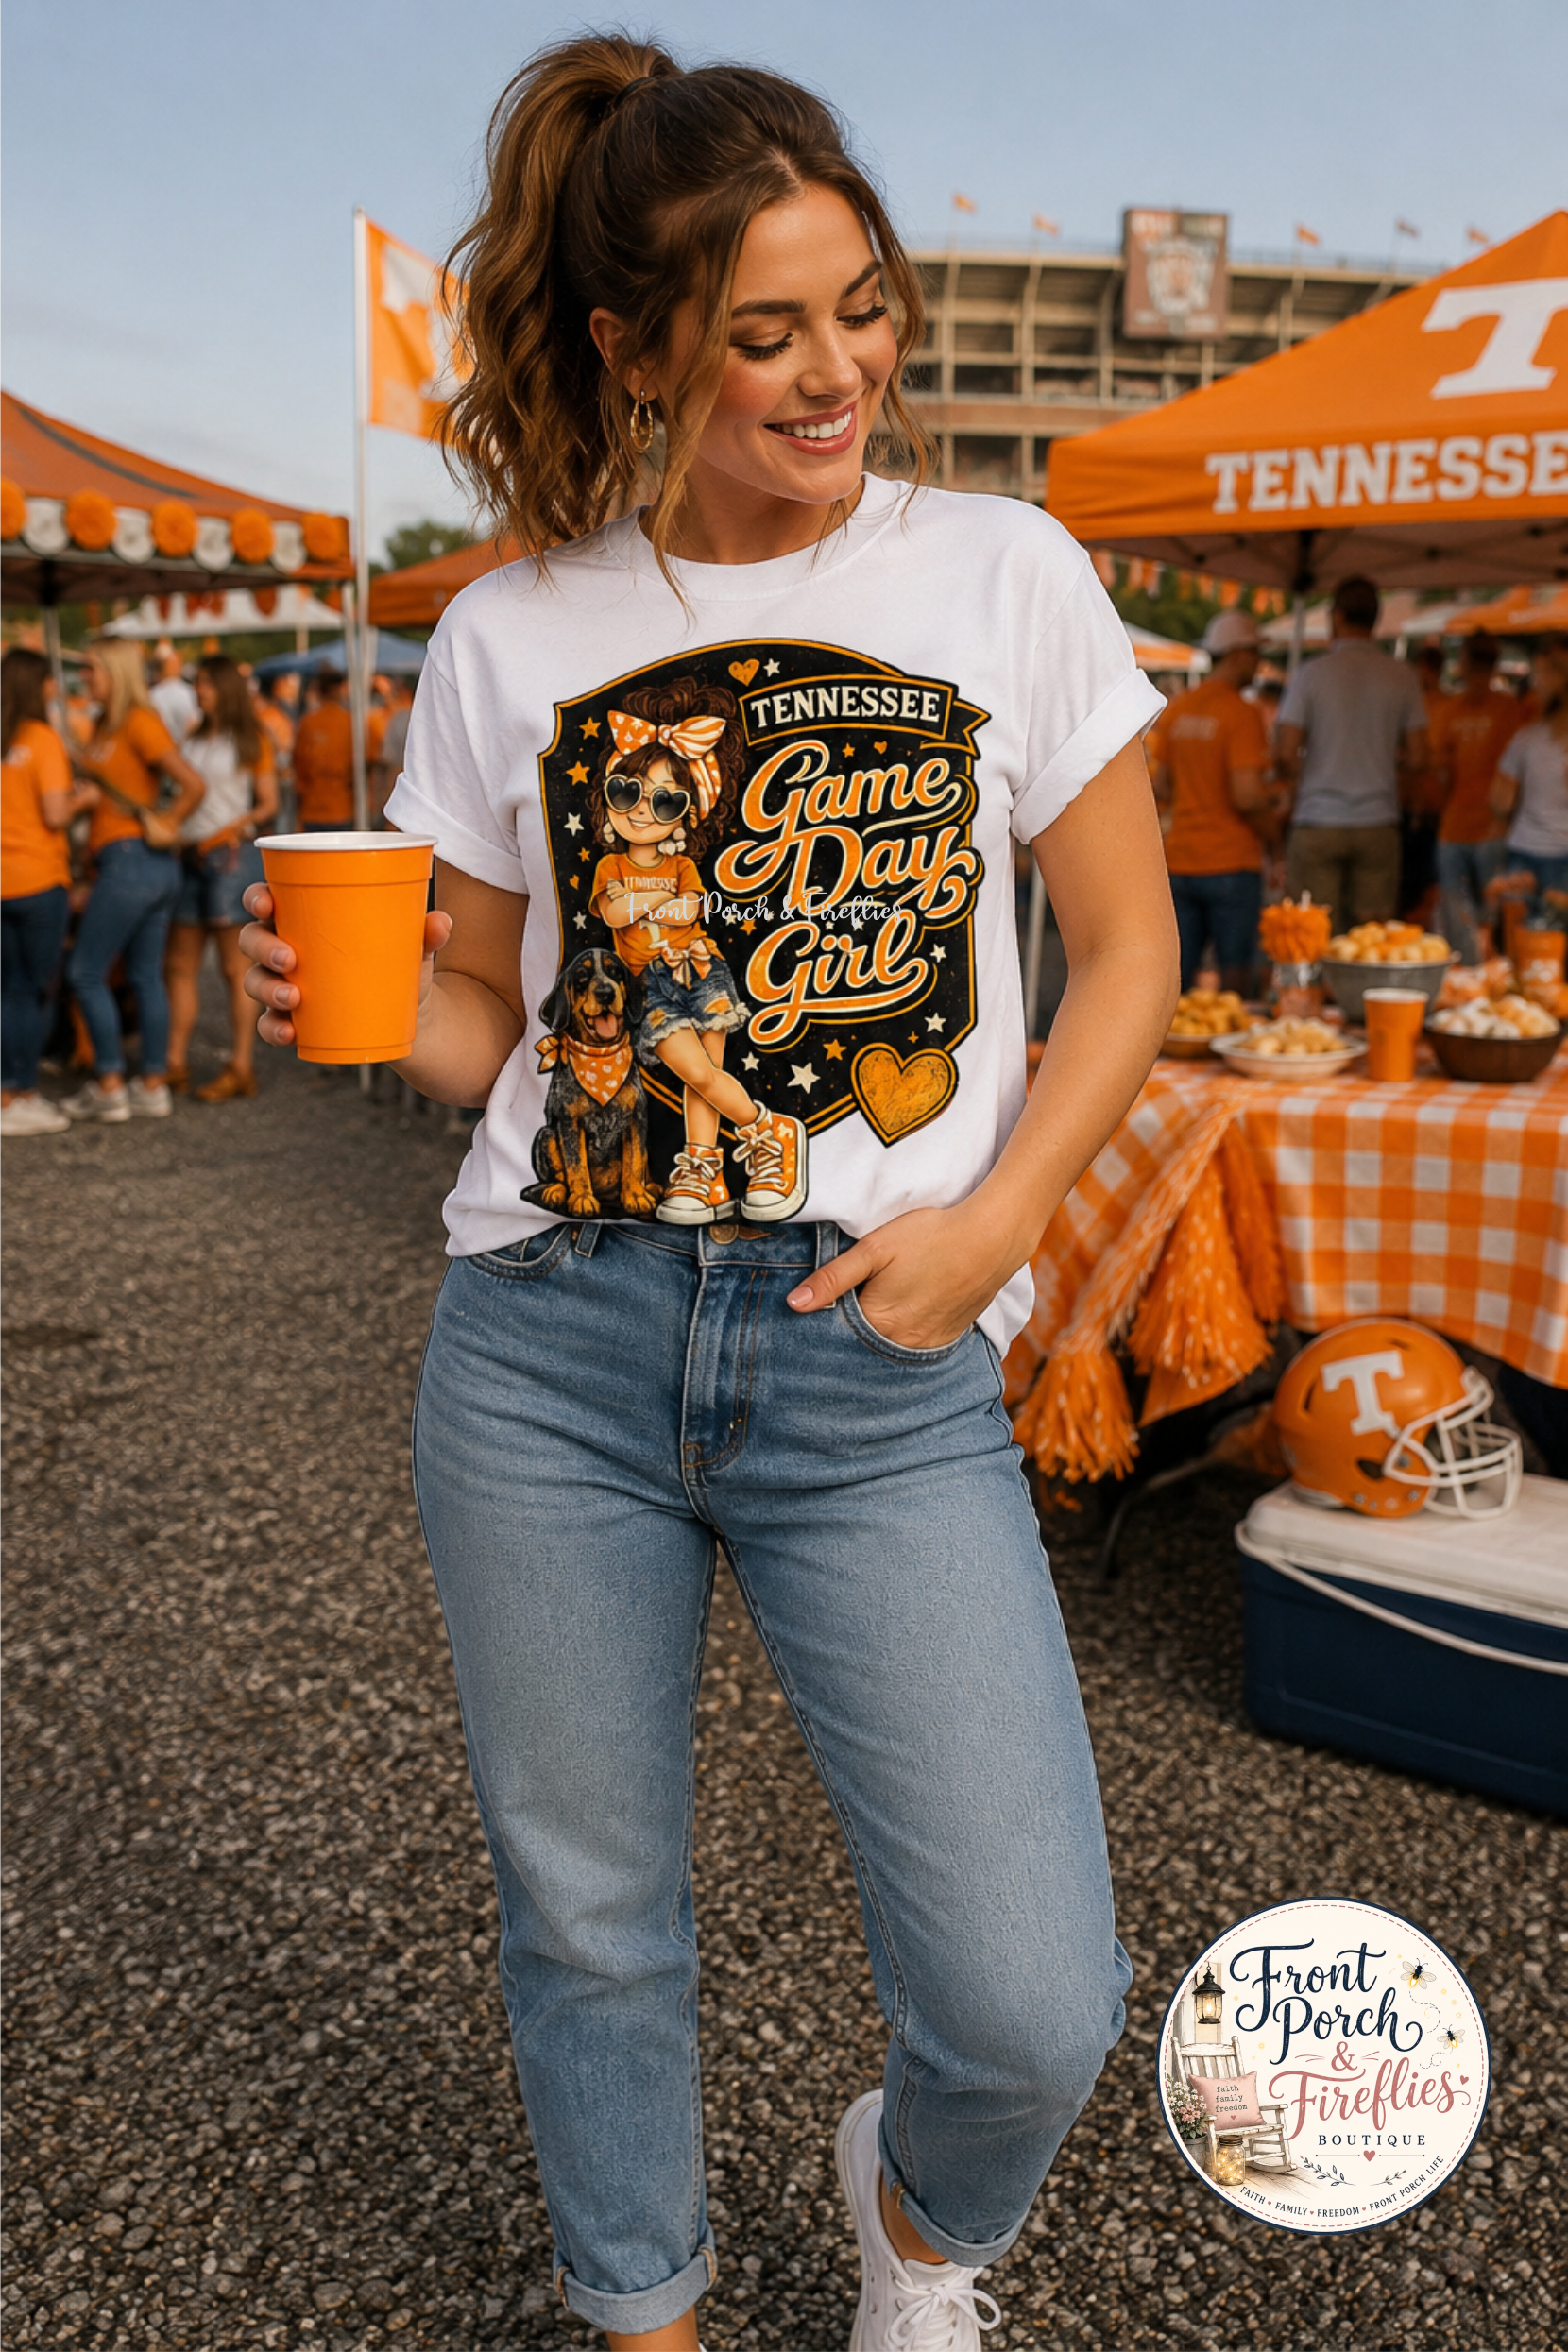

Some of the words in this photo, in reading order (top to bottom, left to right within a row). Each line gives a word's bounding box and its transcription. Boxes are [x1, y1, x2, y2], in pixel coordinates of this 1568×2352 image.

[1421, 277, 1568, 400] T
[750, 686, 940, 728] TENNESSEE
[715, 740, 961, 893] Game
[789, 825, 976, 919] Day
[746, 910, 929, 1044] Girl
[1321, 1350, 1404, 1437] T
